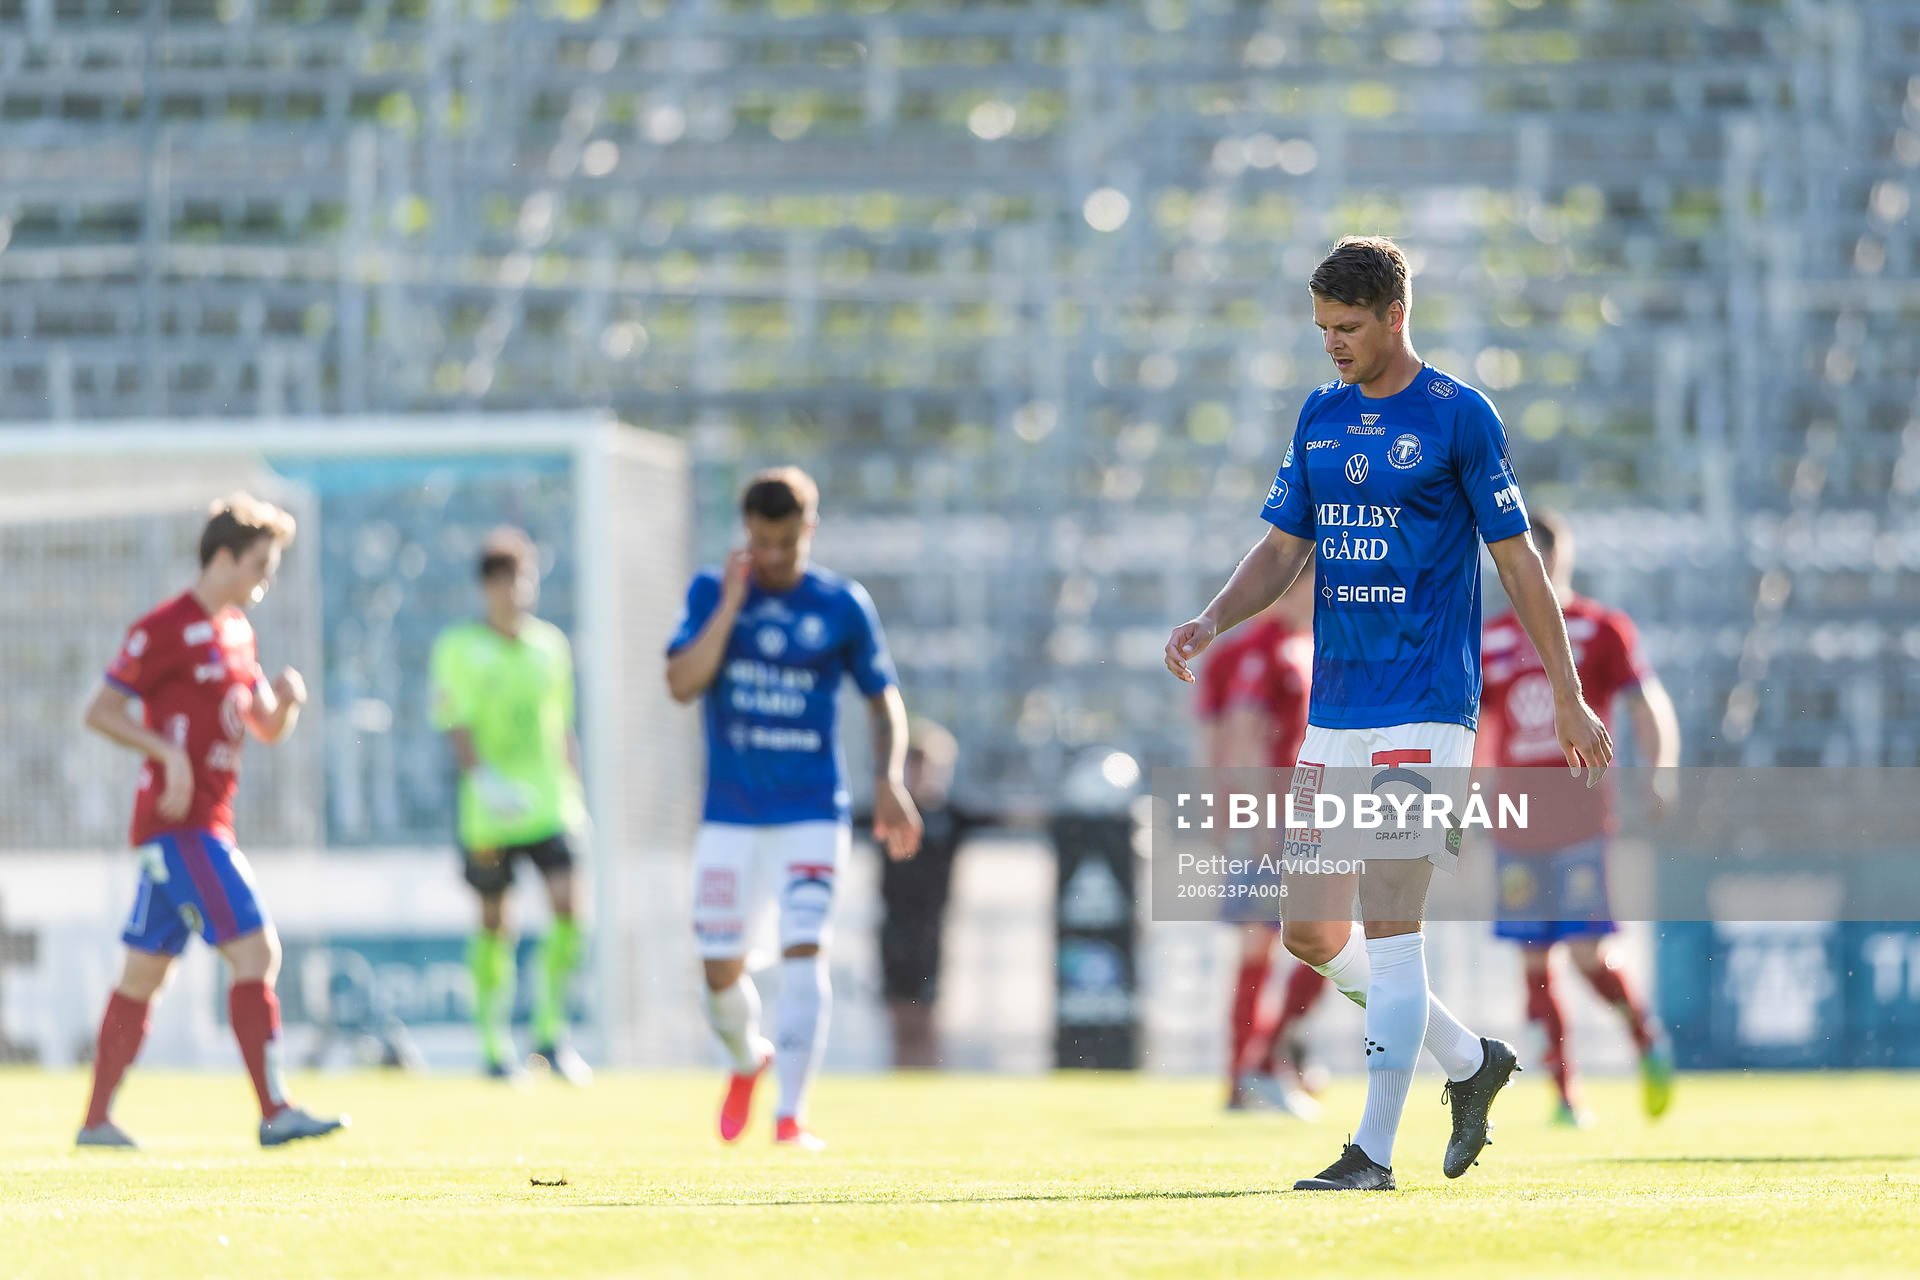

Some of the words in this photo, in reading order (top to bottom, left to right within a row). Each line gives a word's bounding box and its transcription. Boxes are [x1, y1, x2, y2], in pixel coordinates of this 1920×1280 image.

[1346, 425, 1387, 436] TRELLEBORG
[1306, 439, 1334, 451] CRAFT
[1315, 503, 1402, 529] MELLBY
[1322, 532, 1389, 561] GÅRD
[1375, 831, 1412, 841] CRAFT
